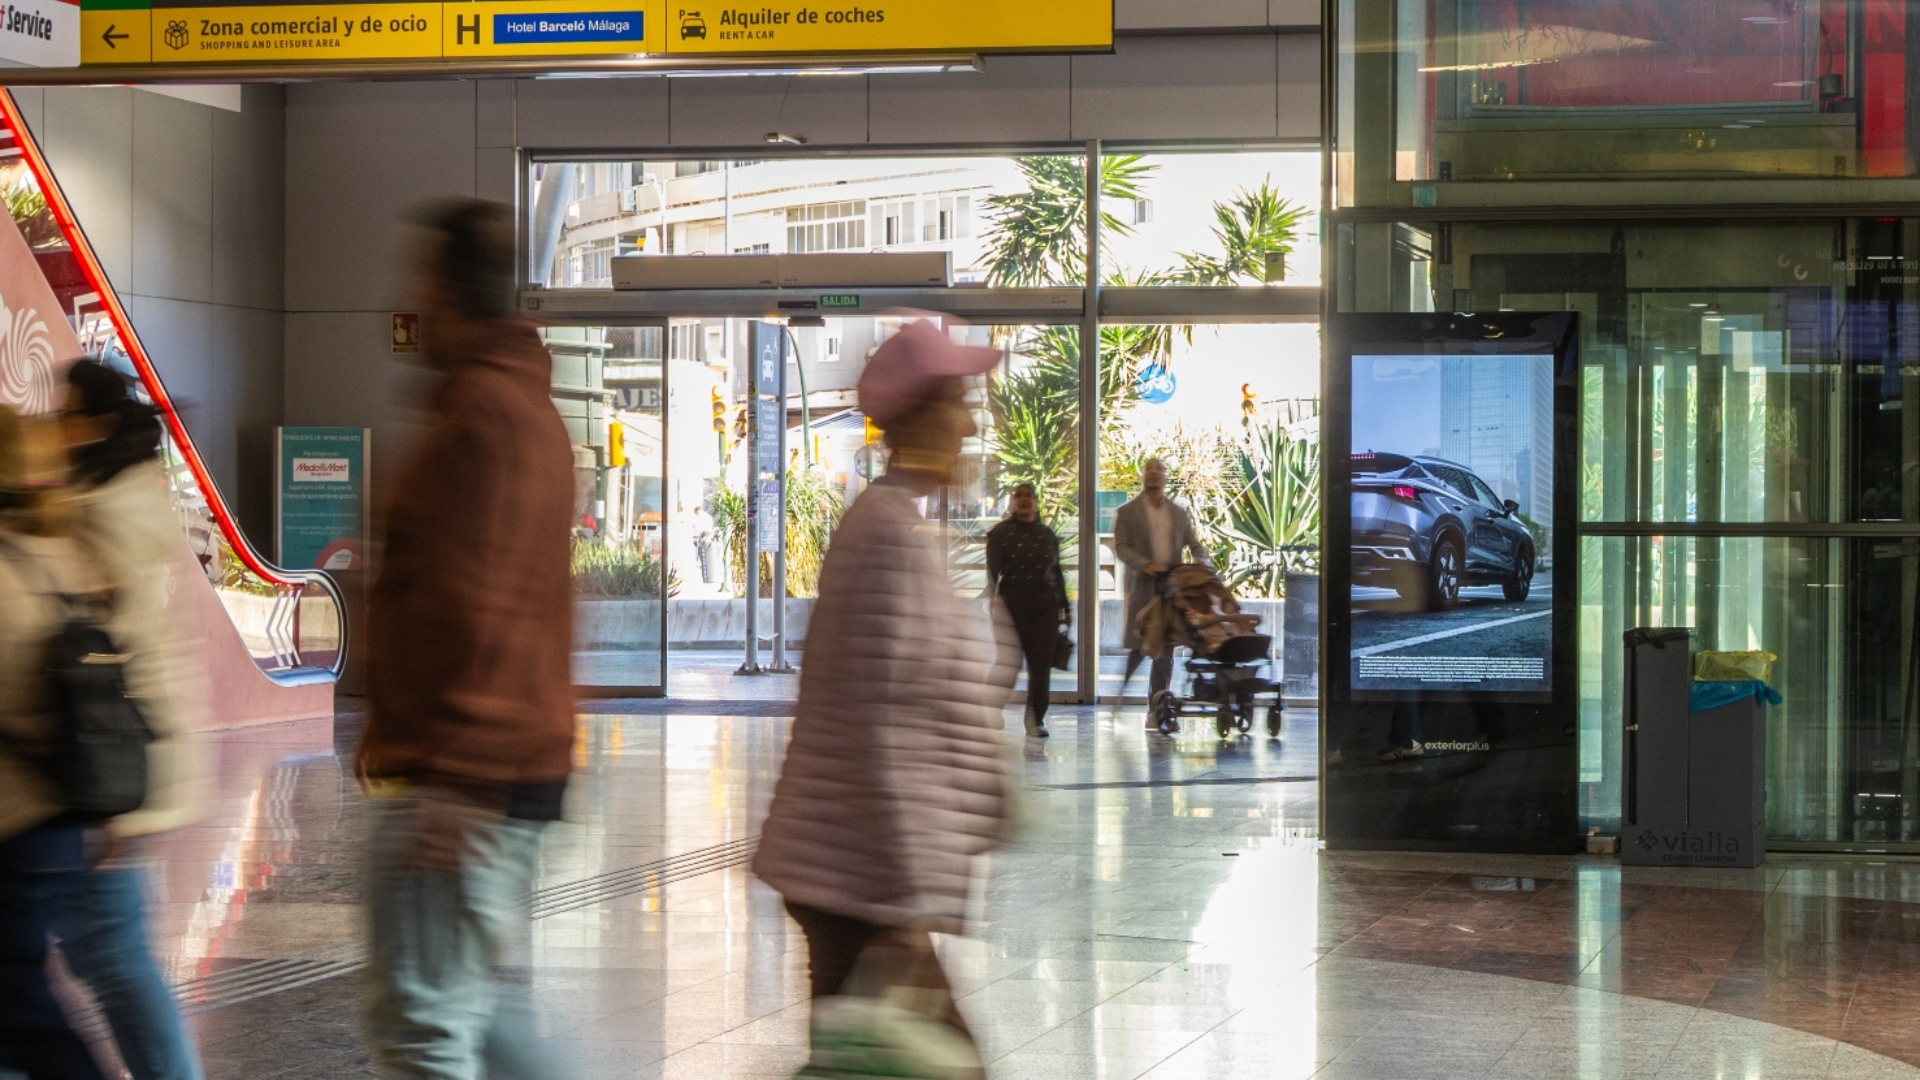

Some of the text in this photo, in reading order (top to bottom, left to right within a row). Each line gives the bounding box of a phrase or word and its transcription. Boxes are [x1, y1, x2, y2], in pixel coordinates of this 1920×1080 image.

[7, 5, 52, 41] Service
[200, 14, 427, 37] Zona comercial y de ocio
[507, 20, 630, 33] Hotel Barceló Málaga
[720, 7, 885, 29] Alquiler de coches
[456, 14, 480, 45] H
[720, 30, 775, 40] RENT A CAR
[200, 39, 341, 50] SHOPPING AND LEISURE AREA
[822, 296, 857, 306] SALIDA
[1424, 740, 1490, 753] exteriorplus
[1661, 831, 1739, 853] vialia
